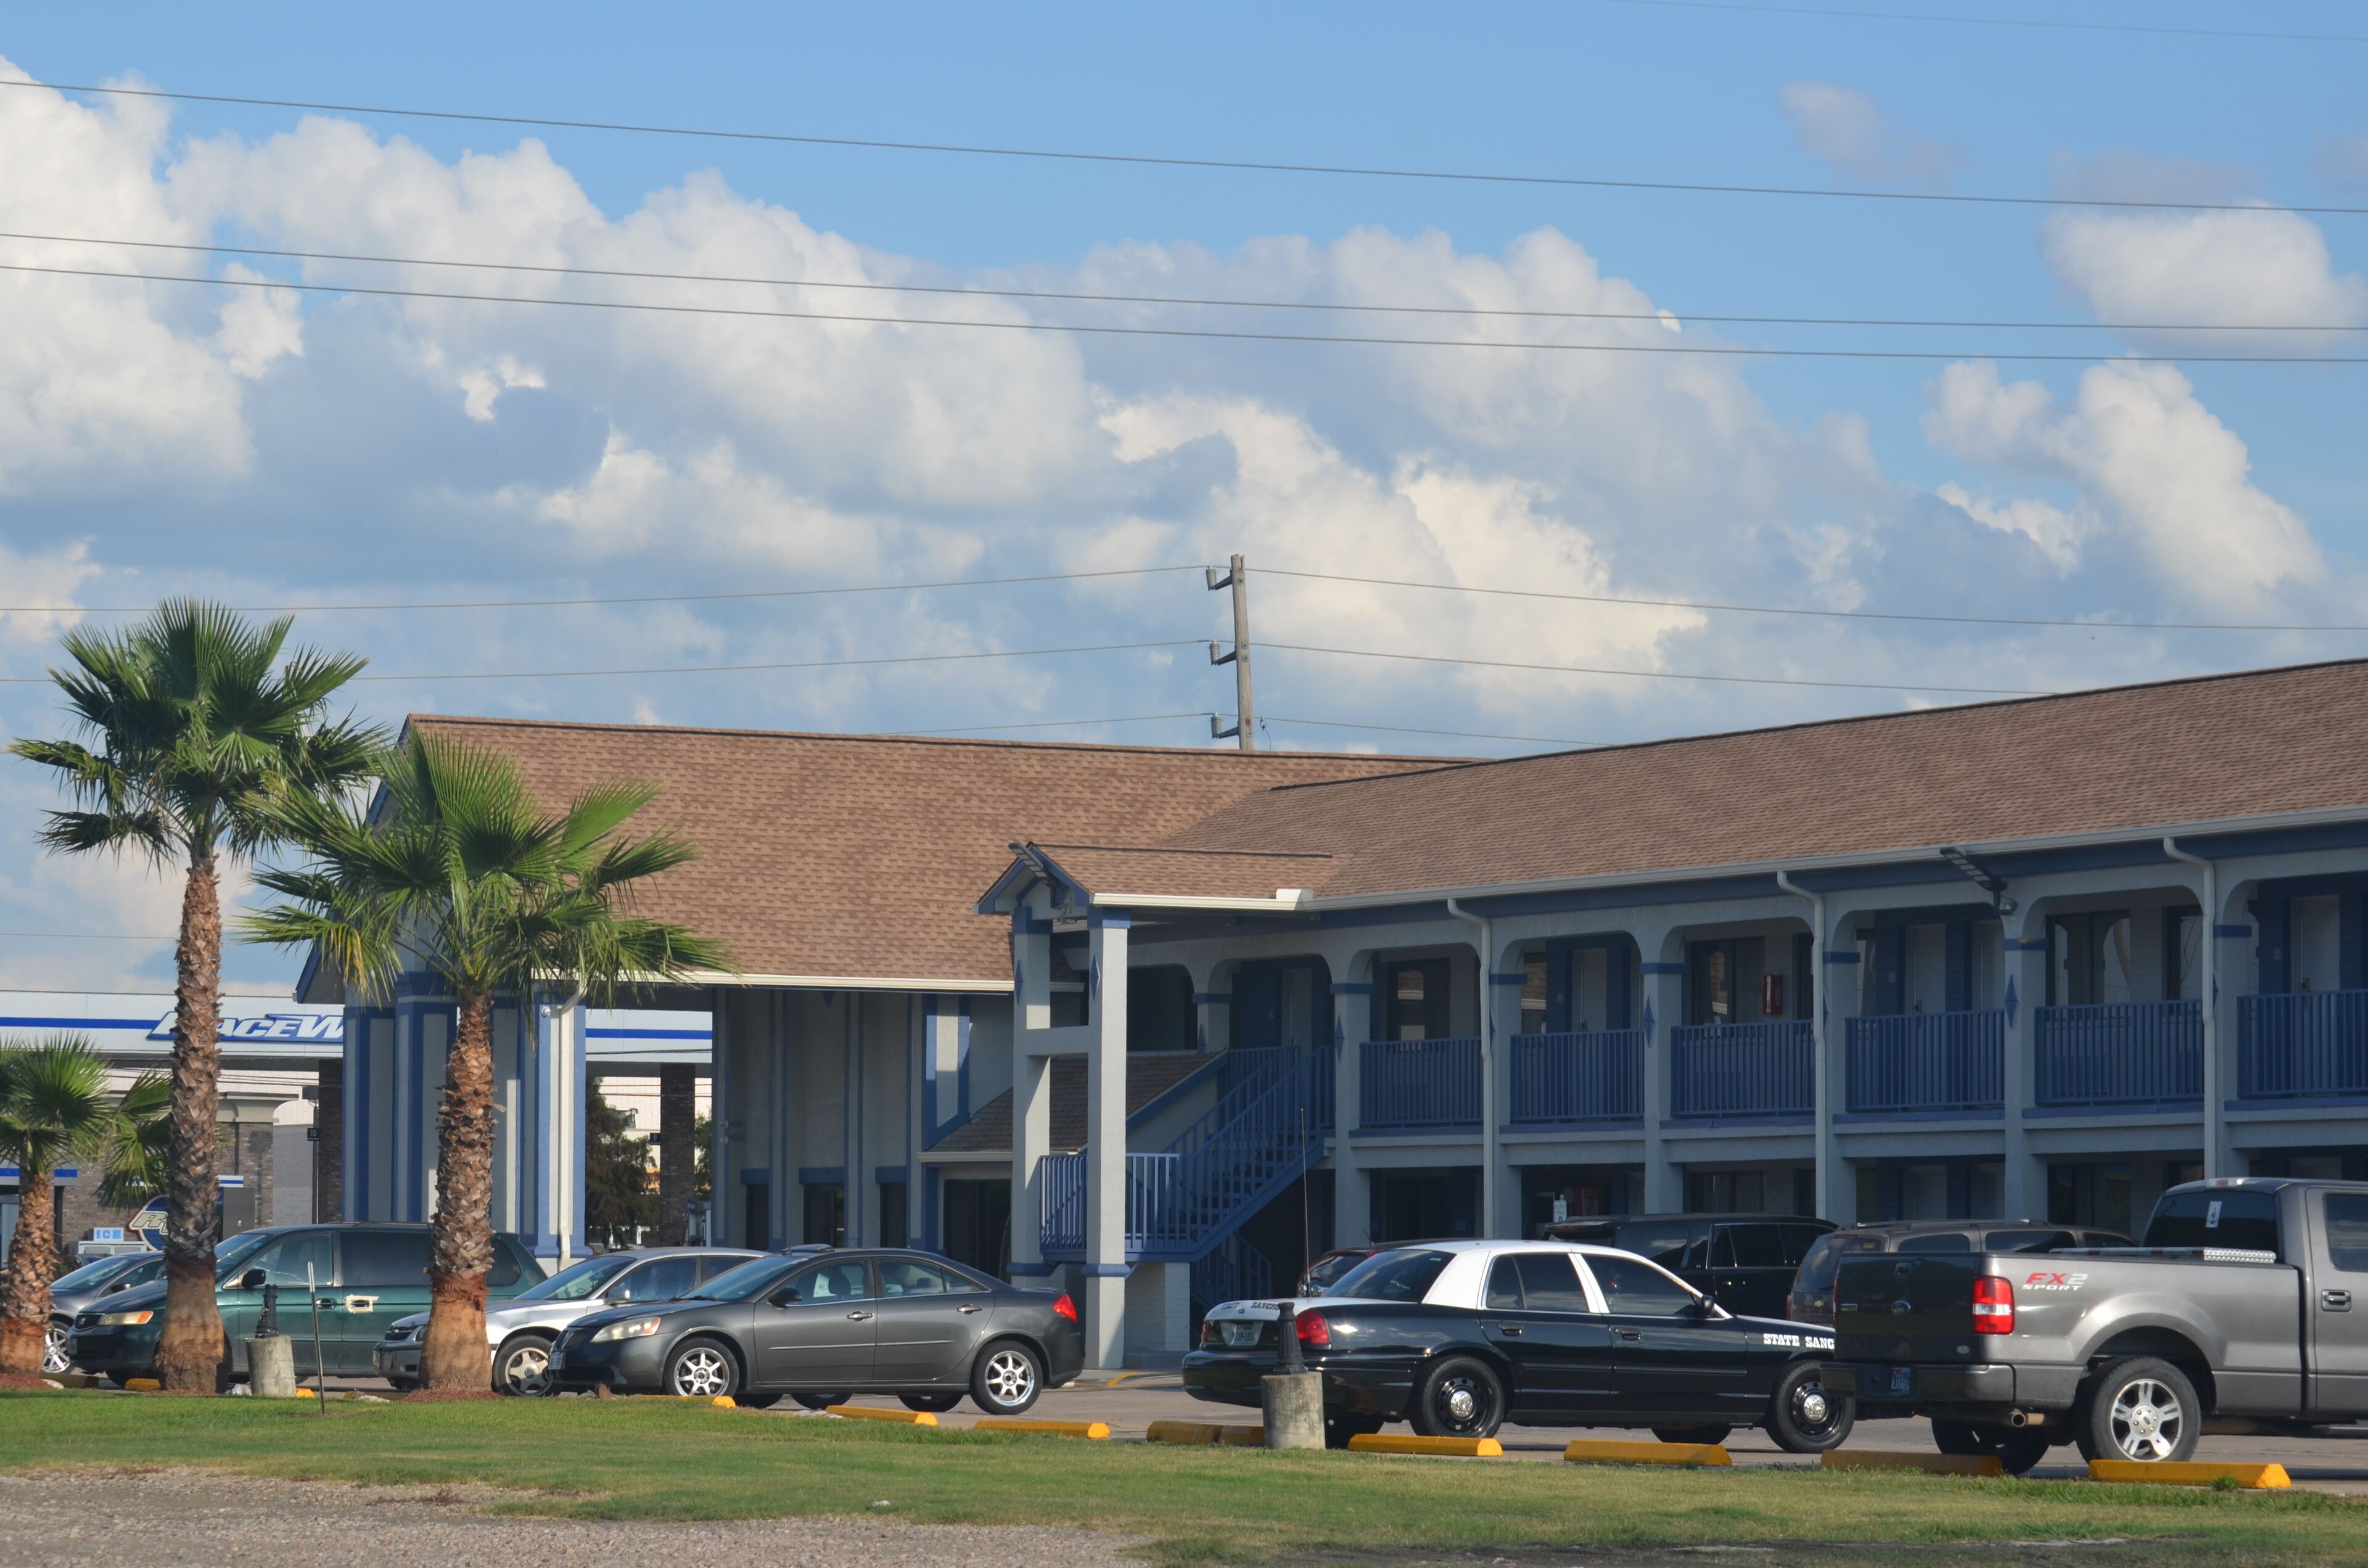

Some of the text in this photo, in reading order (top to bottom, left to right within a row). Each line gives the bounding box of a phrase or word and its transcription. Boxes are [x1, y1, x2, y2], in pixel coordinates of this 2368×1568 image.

[96, 1229, 121, 1239] ICE
[2025, 1273, 2088, 1285] FX2
[1763, 1333, 1800, 1347] STATE
